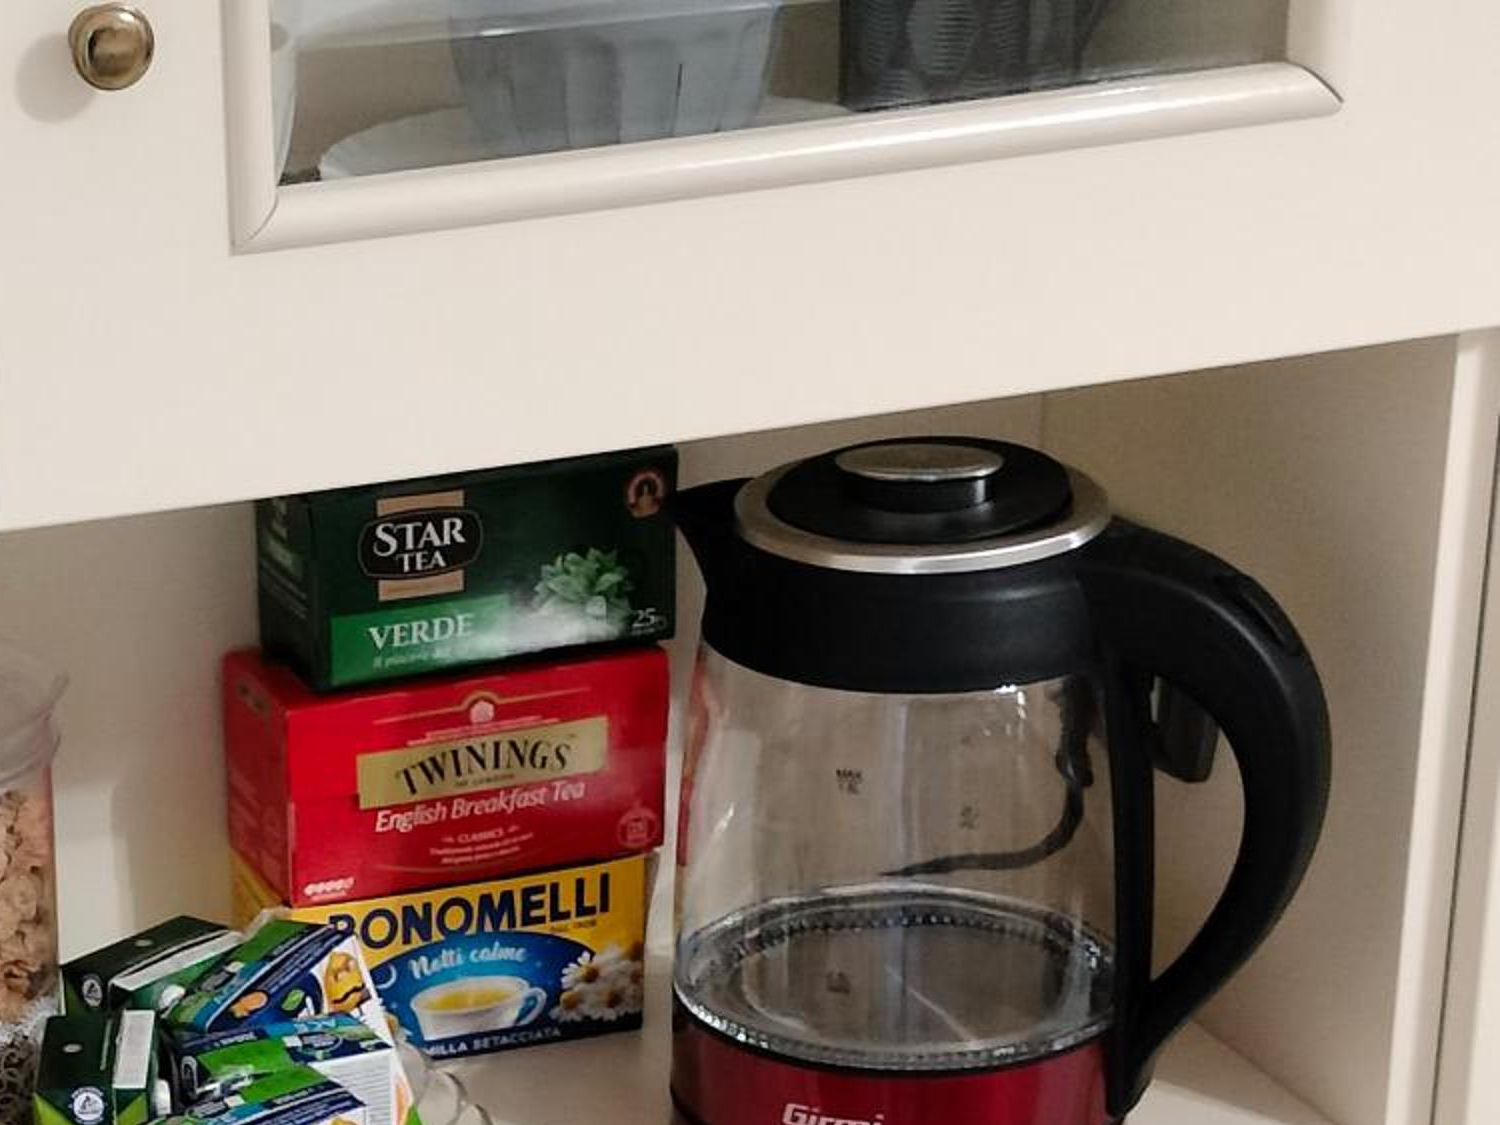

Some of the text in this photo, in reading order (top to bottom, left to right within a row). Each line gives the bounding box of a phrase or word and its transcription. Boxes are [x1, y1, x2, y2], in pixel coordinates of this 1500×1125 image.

[373, 517, 466, 557] STAR
[396, 550, 446, 573] TEA
[368, 613, 474, 650] VERDE
[632, 608, 656, 628] 25
[395, 739, 572, 796] TWININGS
[374, 801, 448, 833] English
[451, 785, 549, 819] Breakfast
[552, 779, 586, 802] Tea
[469, 940, 527, 962] calme
